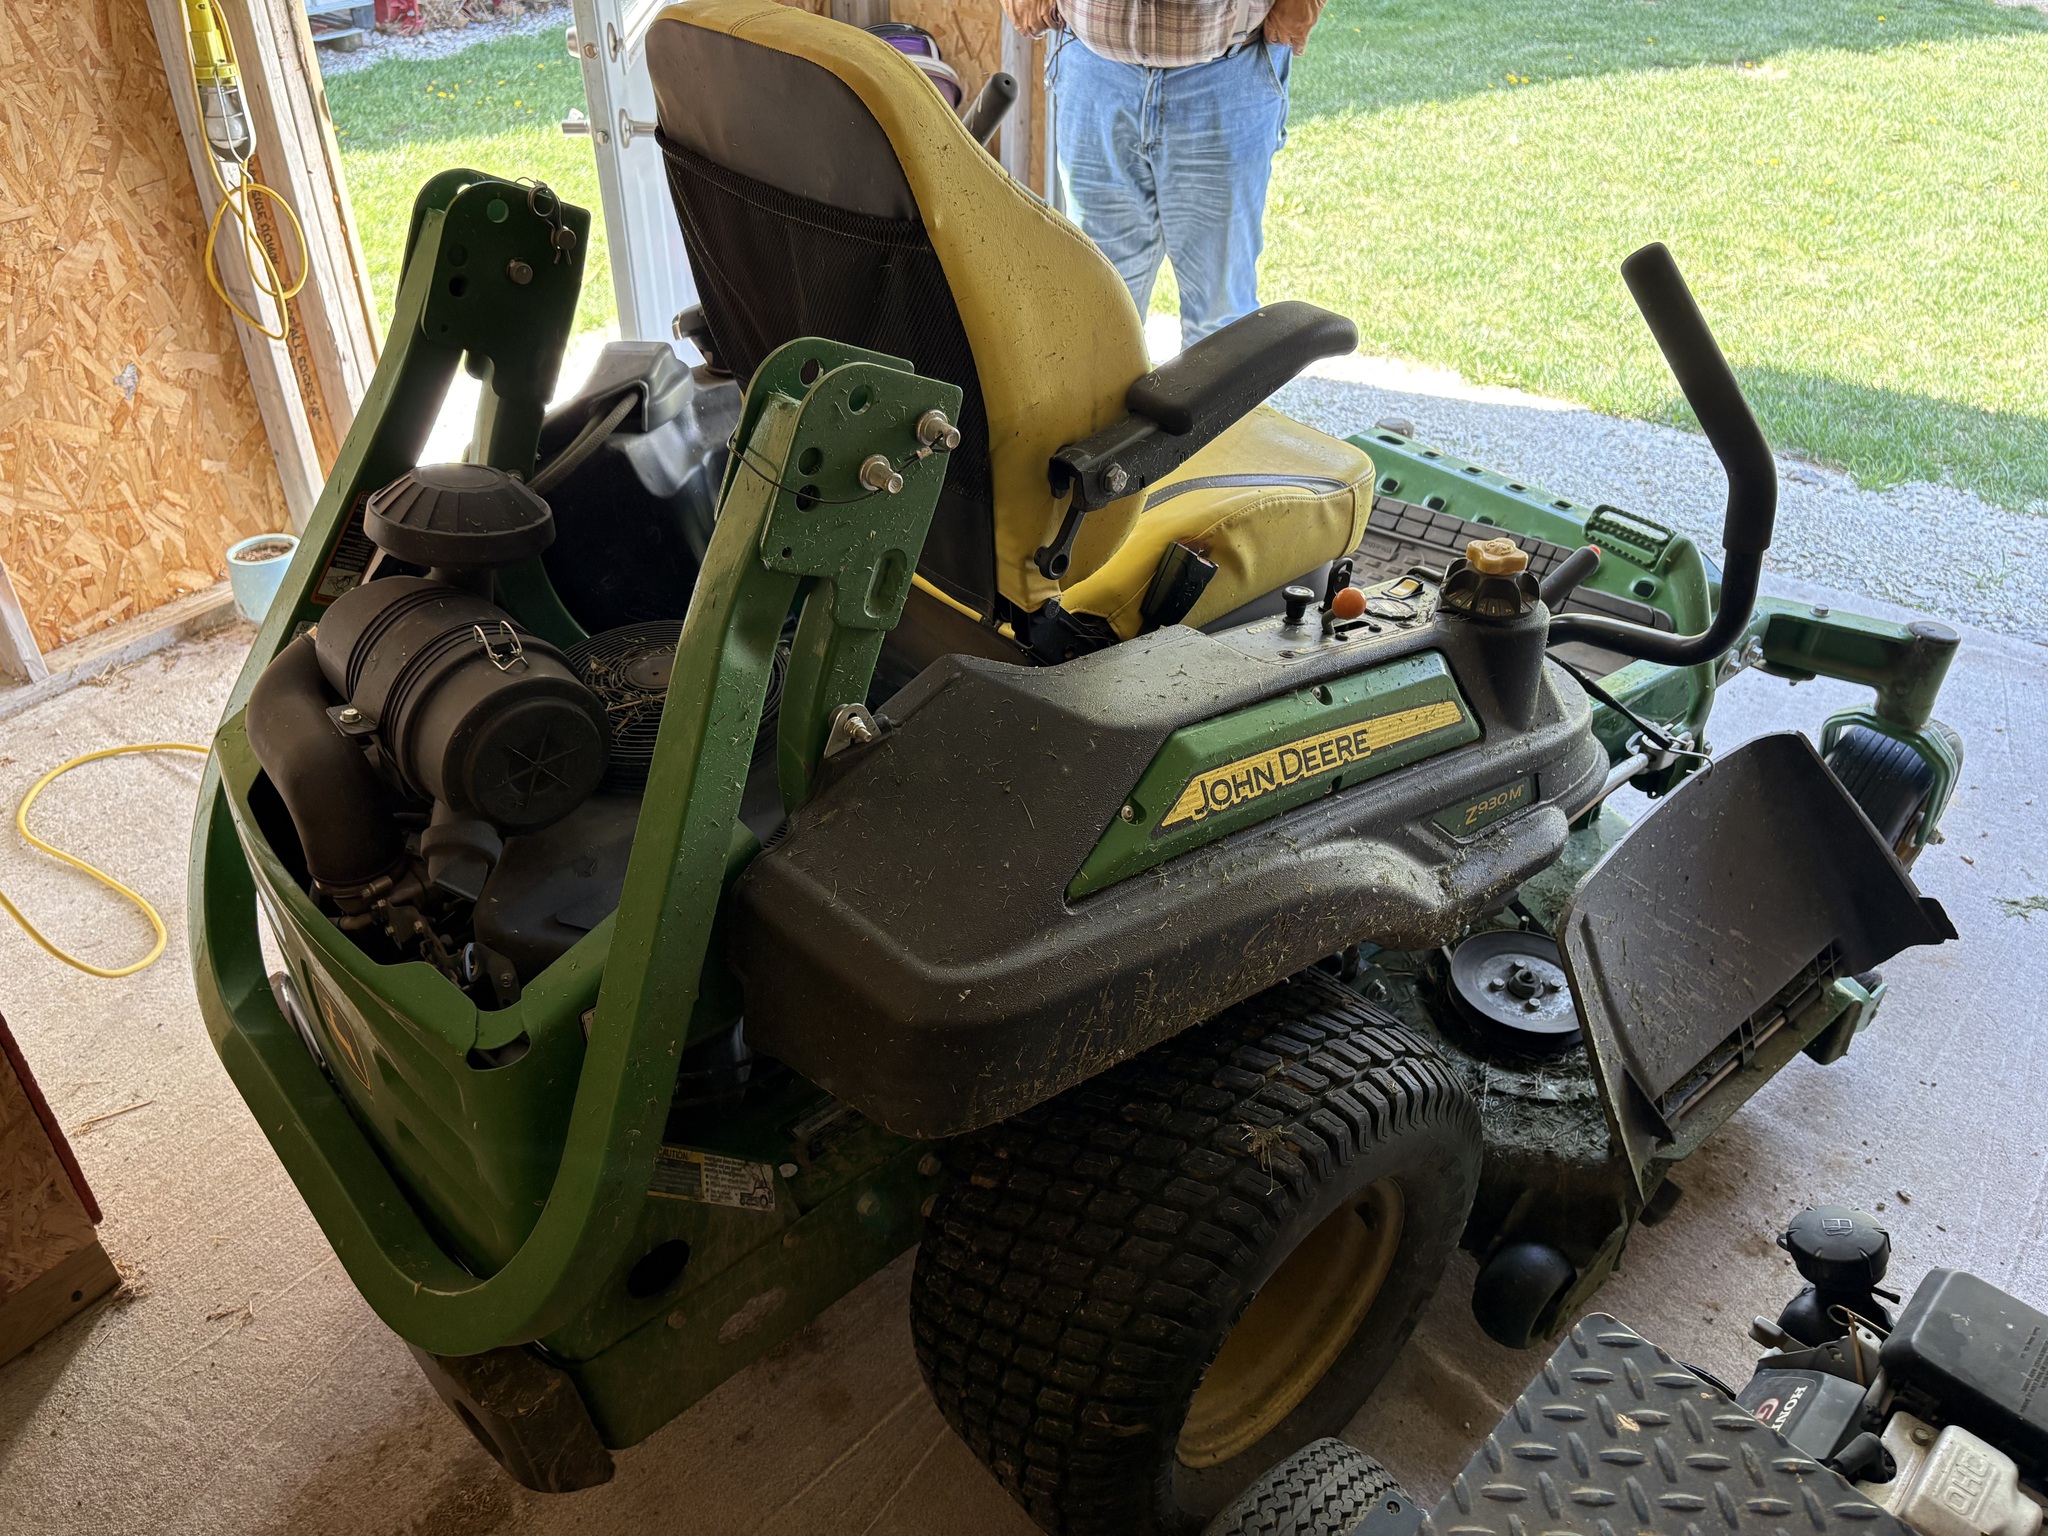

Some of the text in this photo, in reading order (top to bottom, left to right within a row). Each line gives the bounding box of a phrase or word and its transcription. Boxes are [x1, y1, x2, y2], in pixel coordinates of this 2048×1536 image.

[1194, 729, 1371, 815] JOHN DEERE
[1944, 1450, 1990, 1516] OHC
